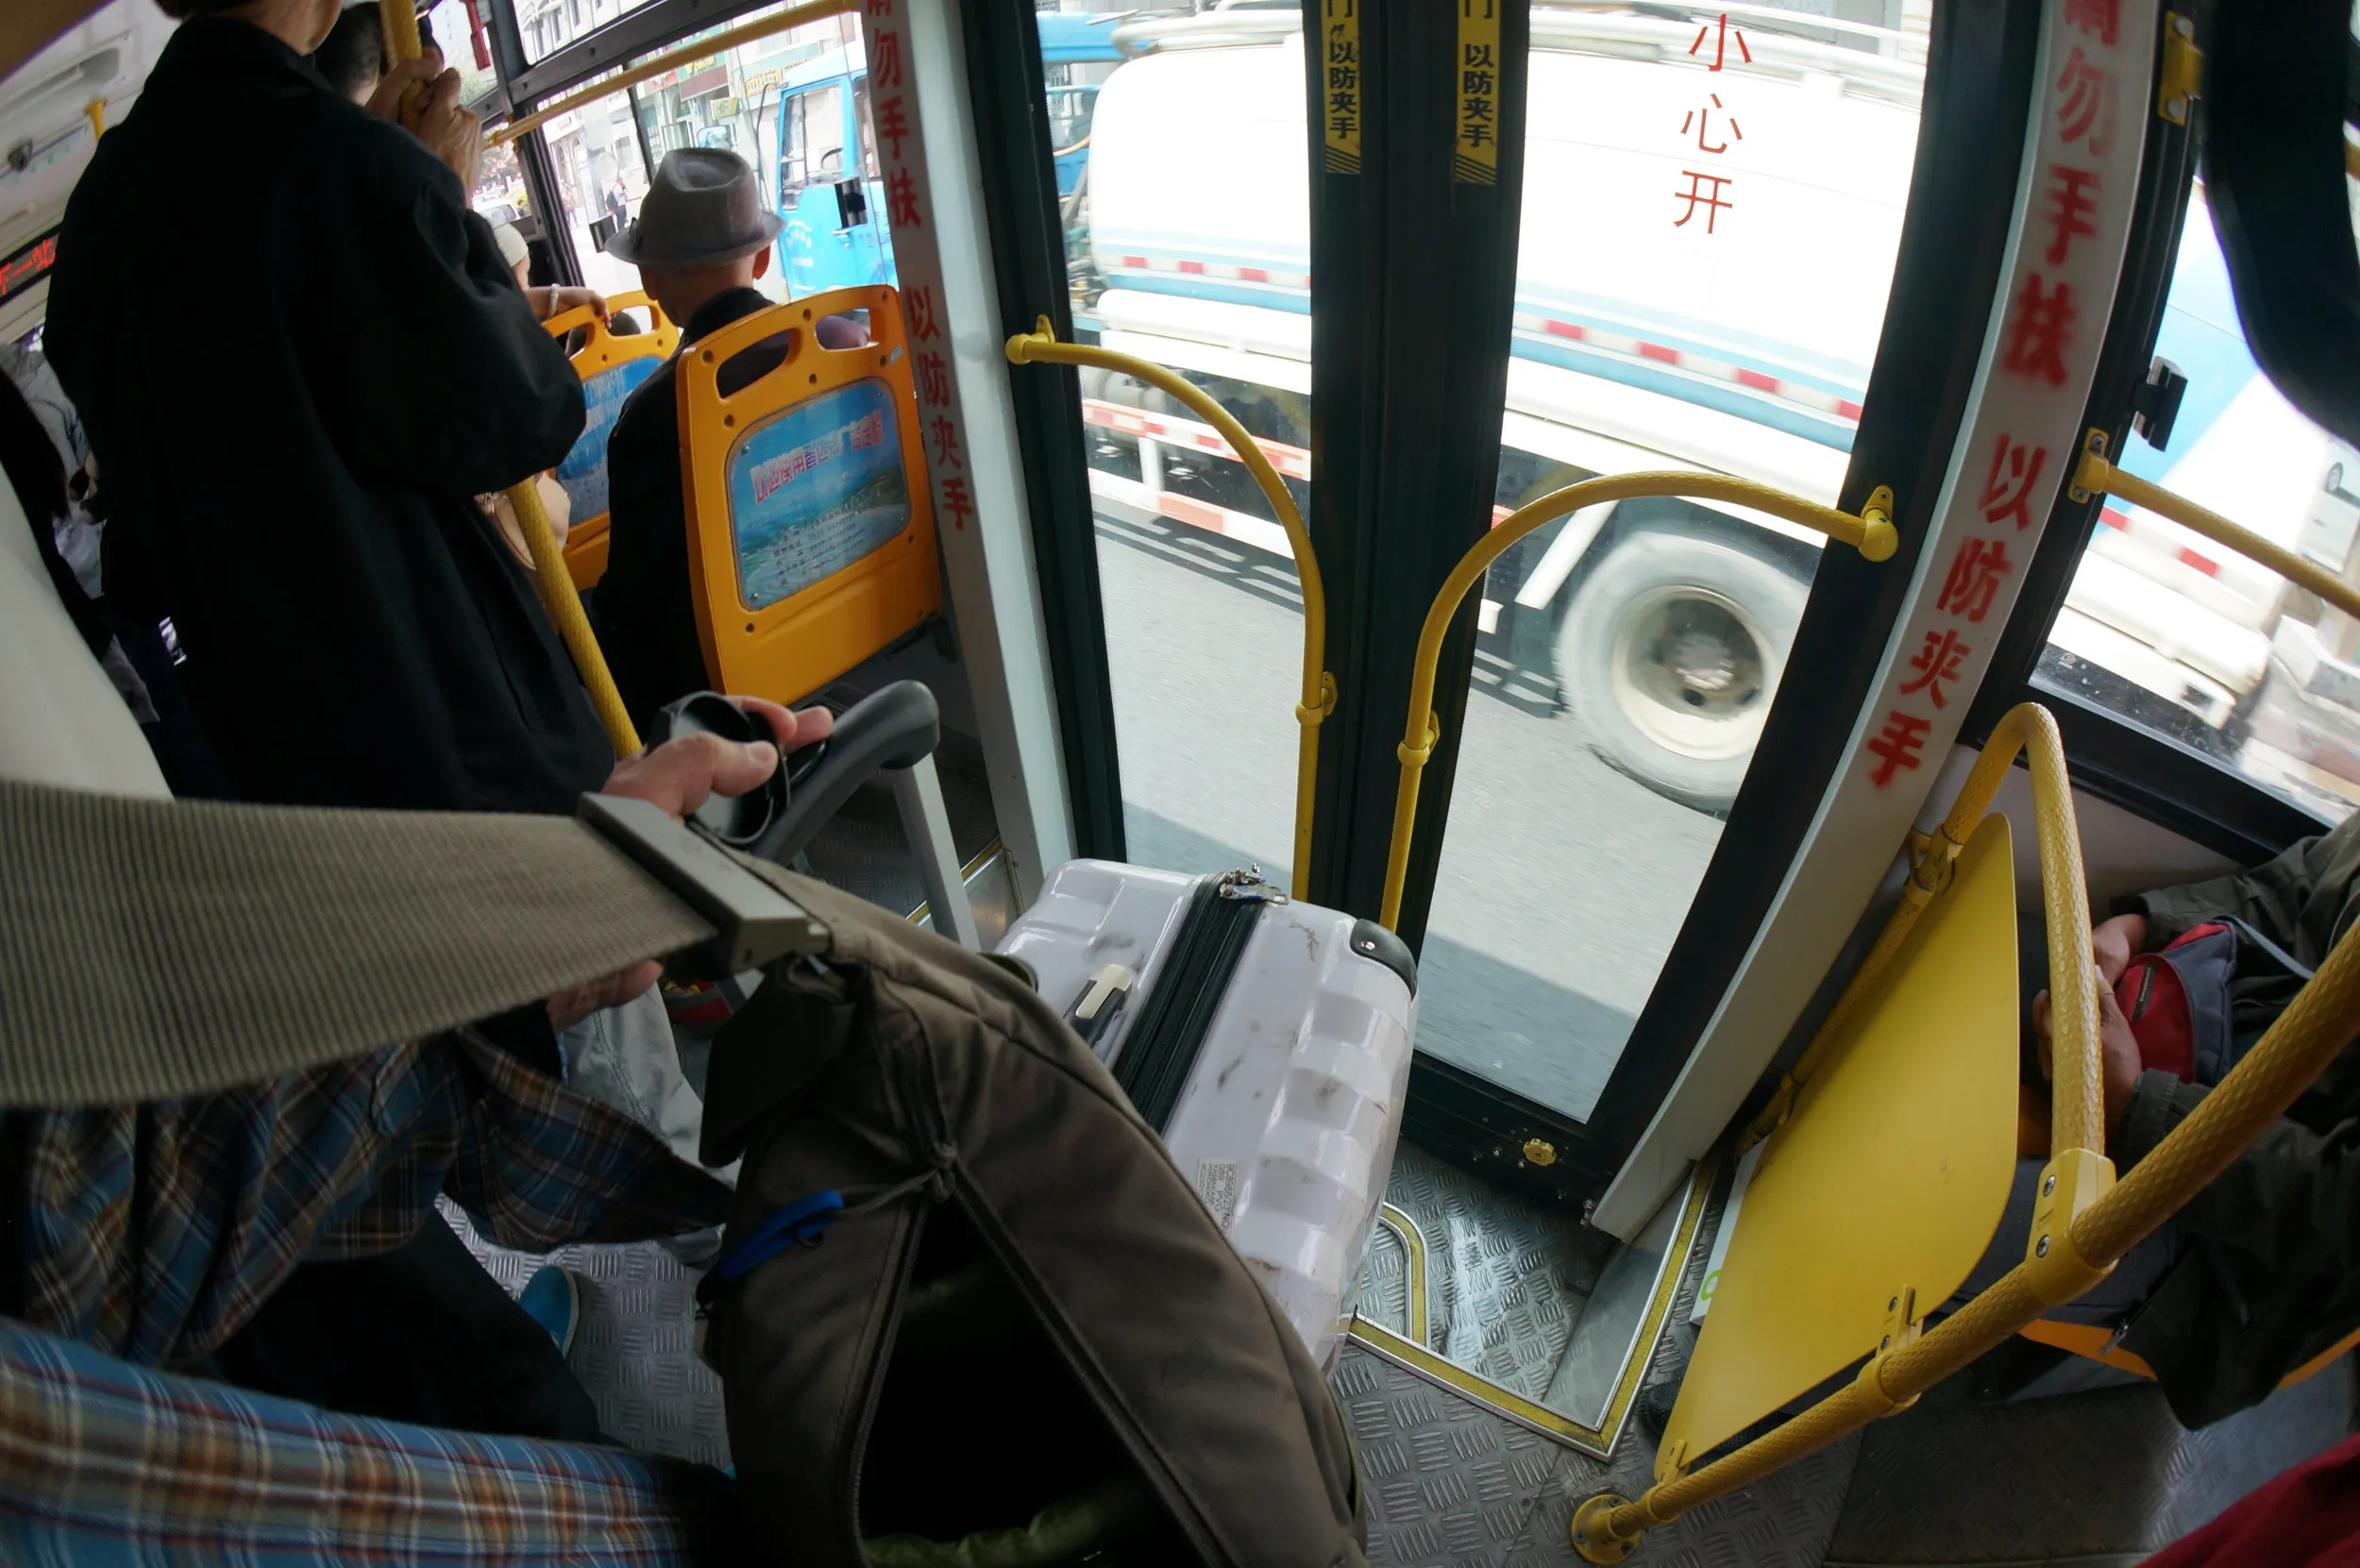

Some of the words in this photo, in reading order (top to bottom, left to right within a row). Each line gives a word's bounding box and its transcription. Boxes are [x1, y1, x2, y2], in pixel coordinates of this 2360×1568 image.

[1328, 41, 1357, 139] 以防夹手
[1461, 43, 1494, 147] 以防夹手
[907, 288, 972, 531] 以防夹手
[1866, 432, 2049, 789] 以防夹手
